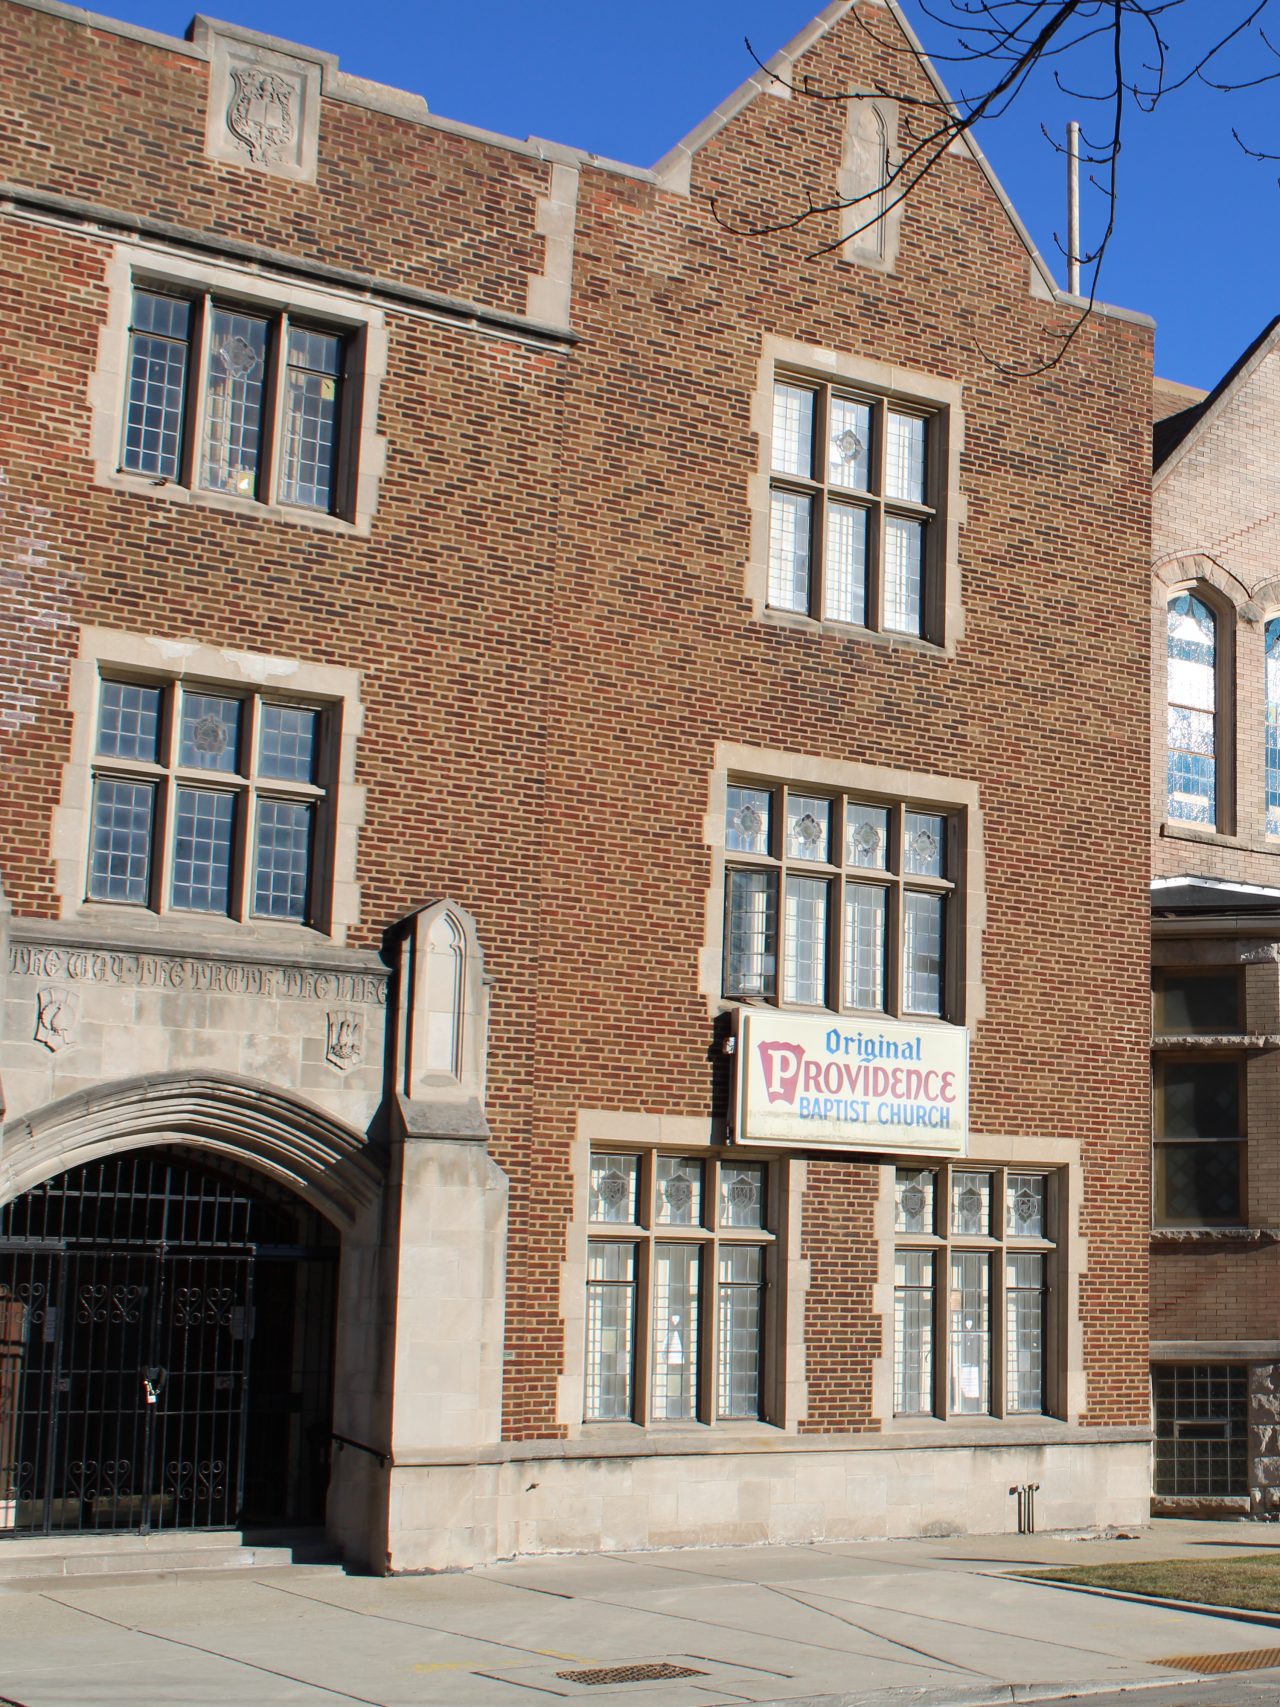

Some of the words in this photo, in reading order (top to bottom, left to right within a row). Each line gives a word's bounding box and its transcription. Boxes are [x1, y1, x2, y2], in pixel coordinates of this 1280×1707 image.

[9, 946, 61, 978] THE
[136, 954, 186, 989] THE
[334, 973, 388, 1005] LIFE
[825, 1028, 923, 1063] Original
[767, 1049, 957, 1103] PROVIDENCE
[799, 1096, 870, 1123] BAPTIST
[877, 1102, 950, 1129] CHURCH
